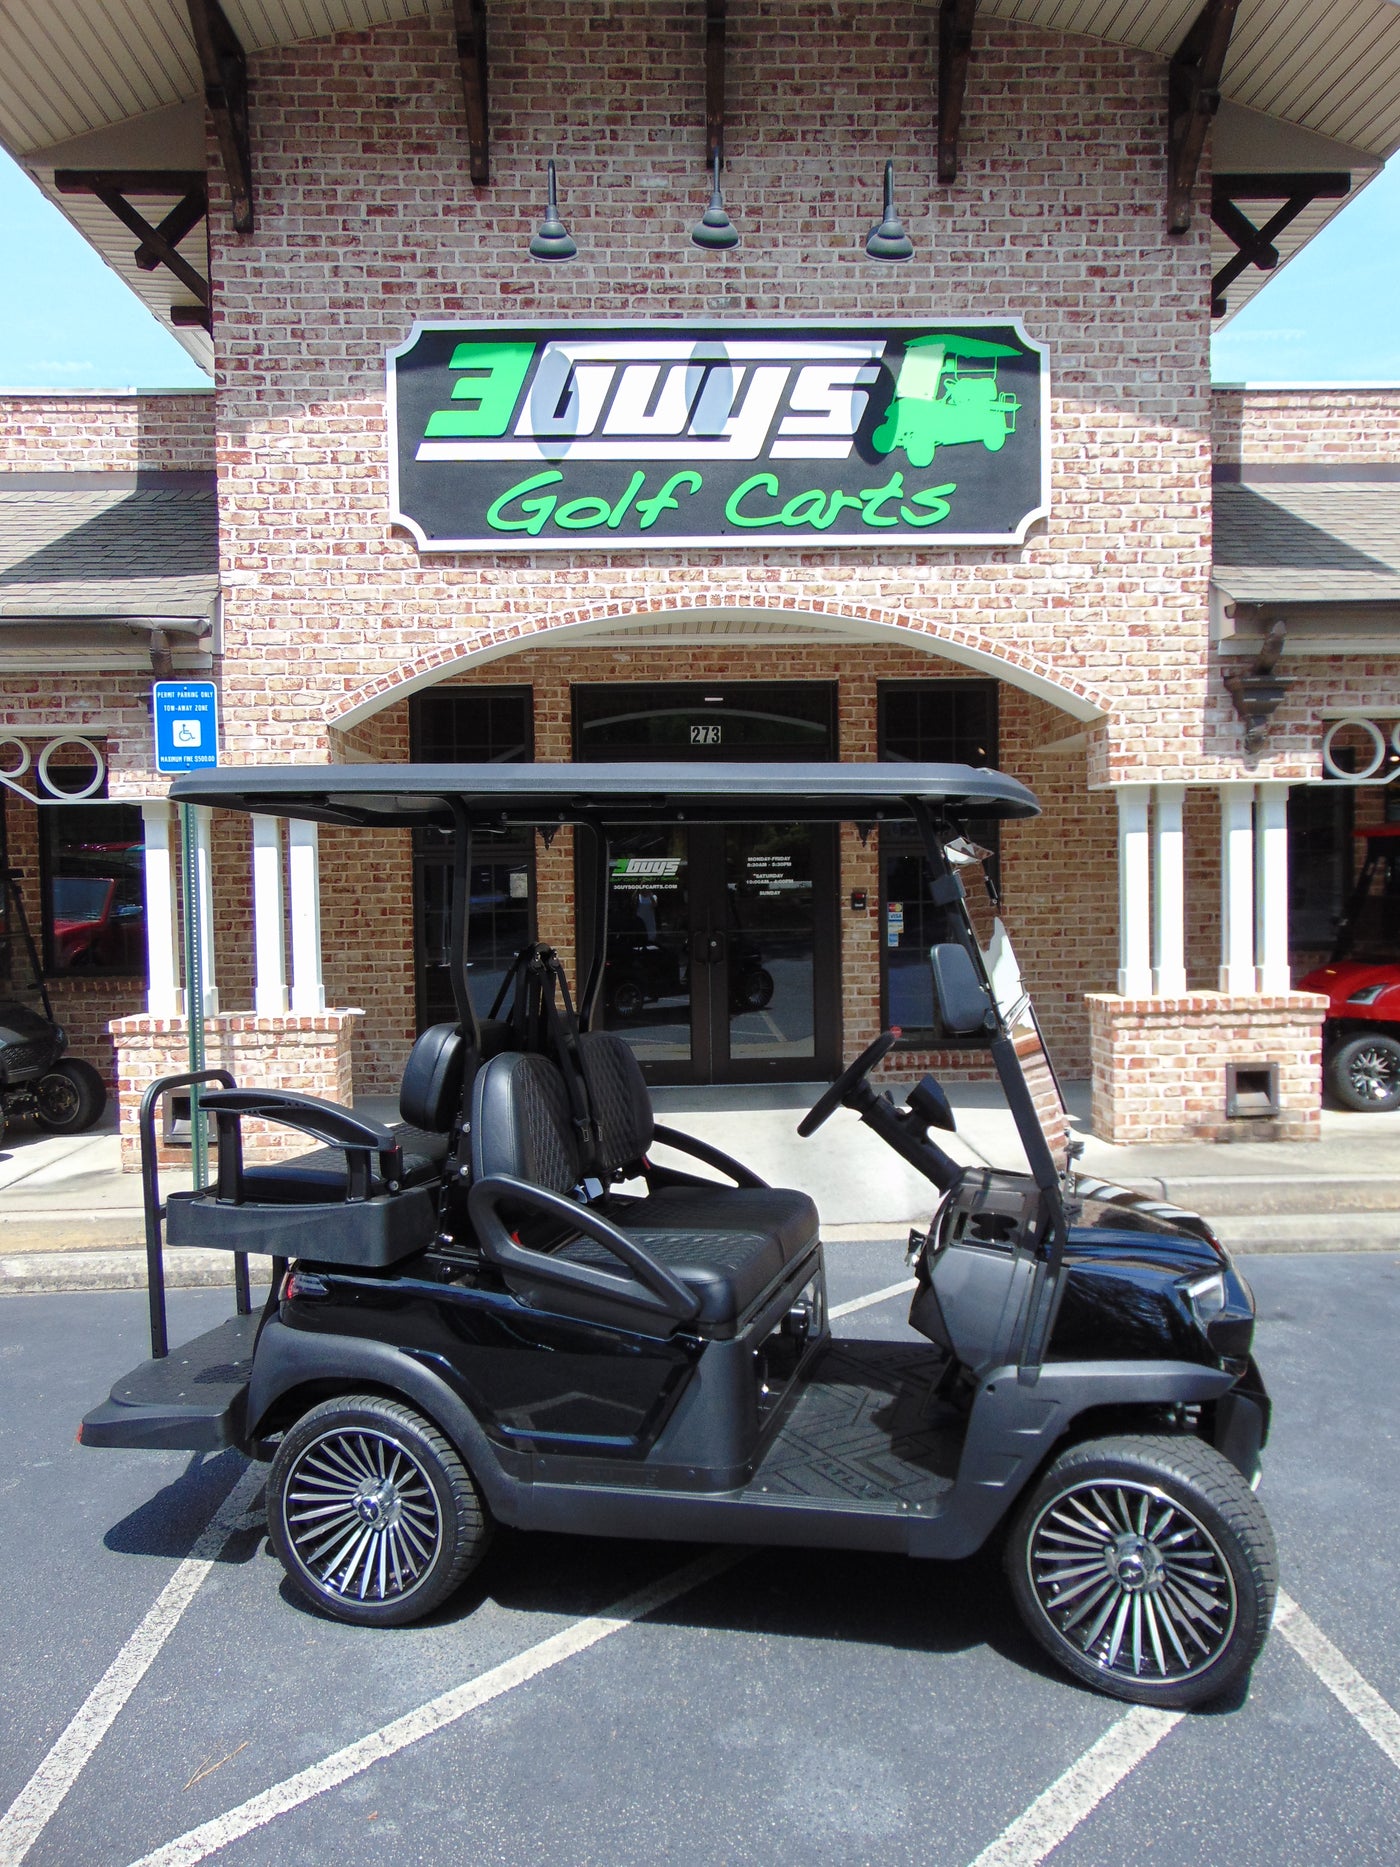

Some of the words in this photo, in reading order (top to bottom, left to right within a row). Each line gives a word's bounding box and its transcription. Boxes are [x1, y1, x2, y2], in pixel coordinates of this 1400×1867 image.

[486, 470, 702, 535] Golf
[725, 472, 957, 530] Carts
[163, 704, 192, 712] TOW-AWAY
[194, 704, 209, 712] ZONE
[691, 726, 720, 743] 273
